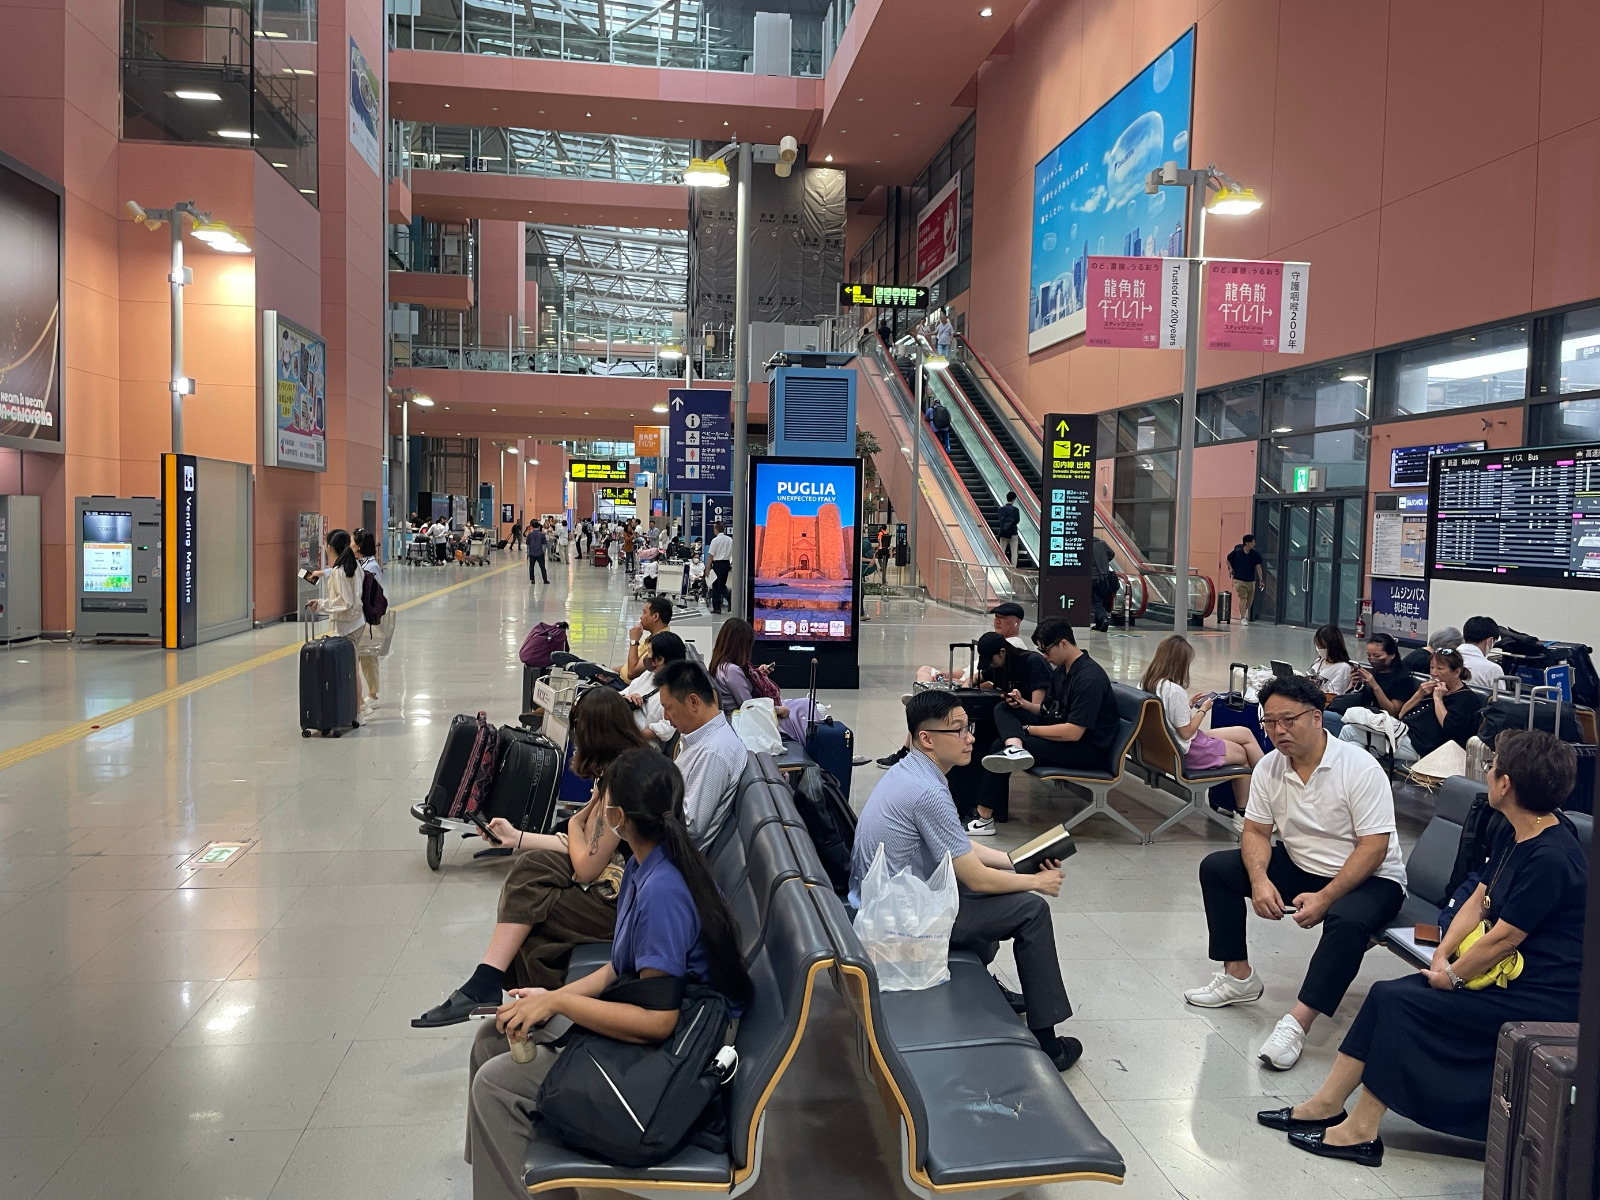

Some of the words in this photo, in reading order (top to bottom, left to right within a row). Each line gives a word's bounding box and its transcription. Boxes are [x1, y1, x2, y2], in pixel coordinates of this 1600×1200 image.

[1104, 279, 1146, 298] 龍角散
[1172, 265, 1180, 296] Trusted
[1225, 282, 1266, 302] 龍角散
[1098, 300, 1152, 320] ダイレクト
[1171, 297, 1179, 308] for
[1218, 304, 1272, 324] ダイレクト
[1074, 443, 1090, 457] 2F
[778, 481, 836, 495] PUGLIA
[1060, 595, 1074, 609] 1F
[1394, 601, 1420, 615] 机场巴士
